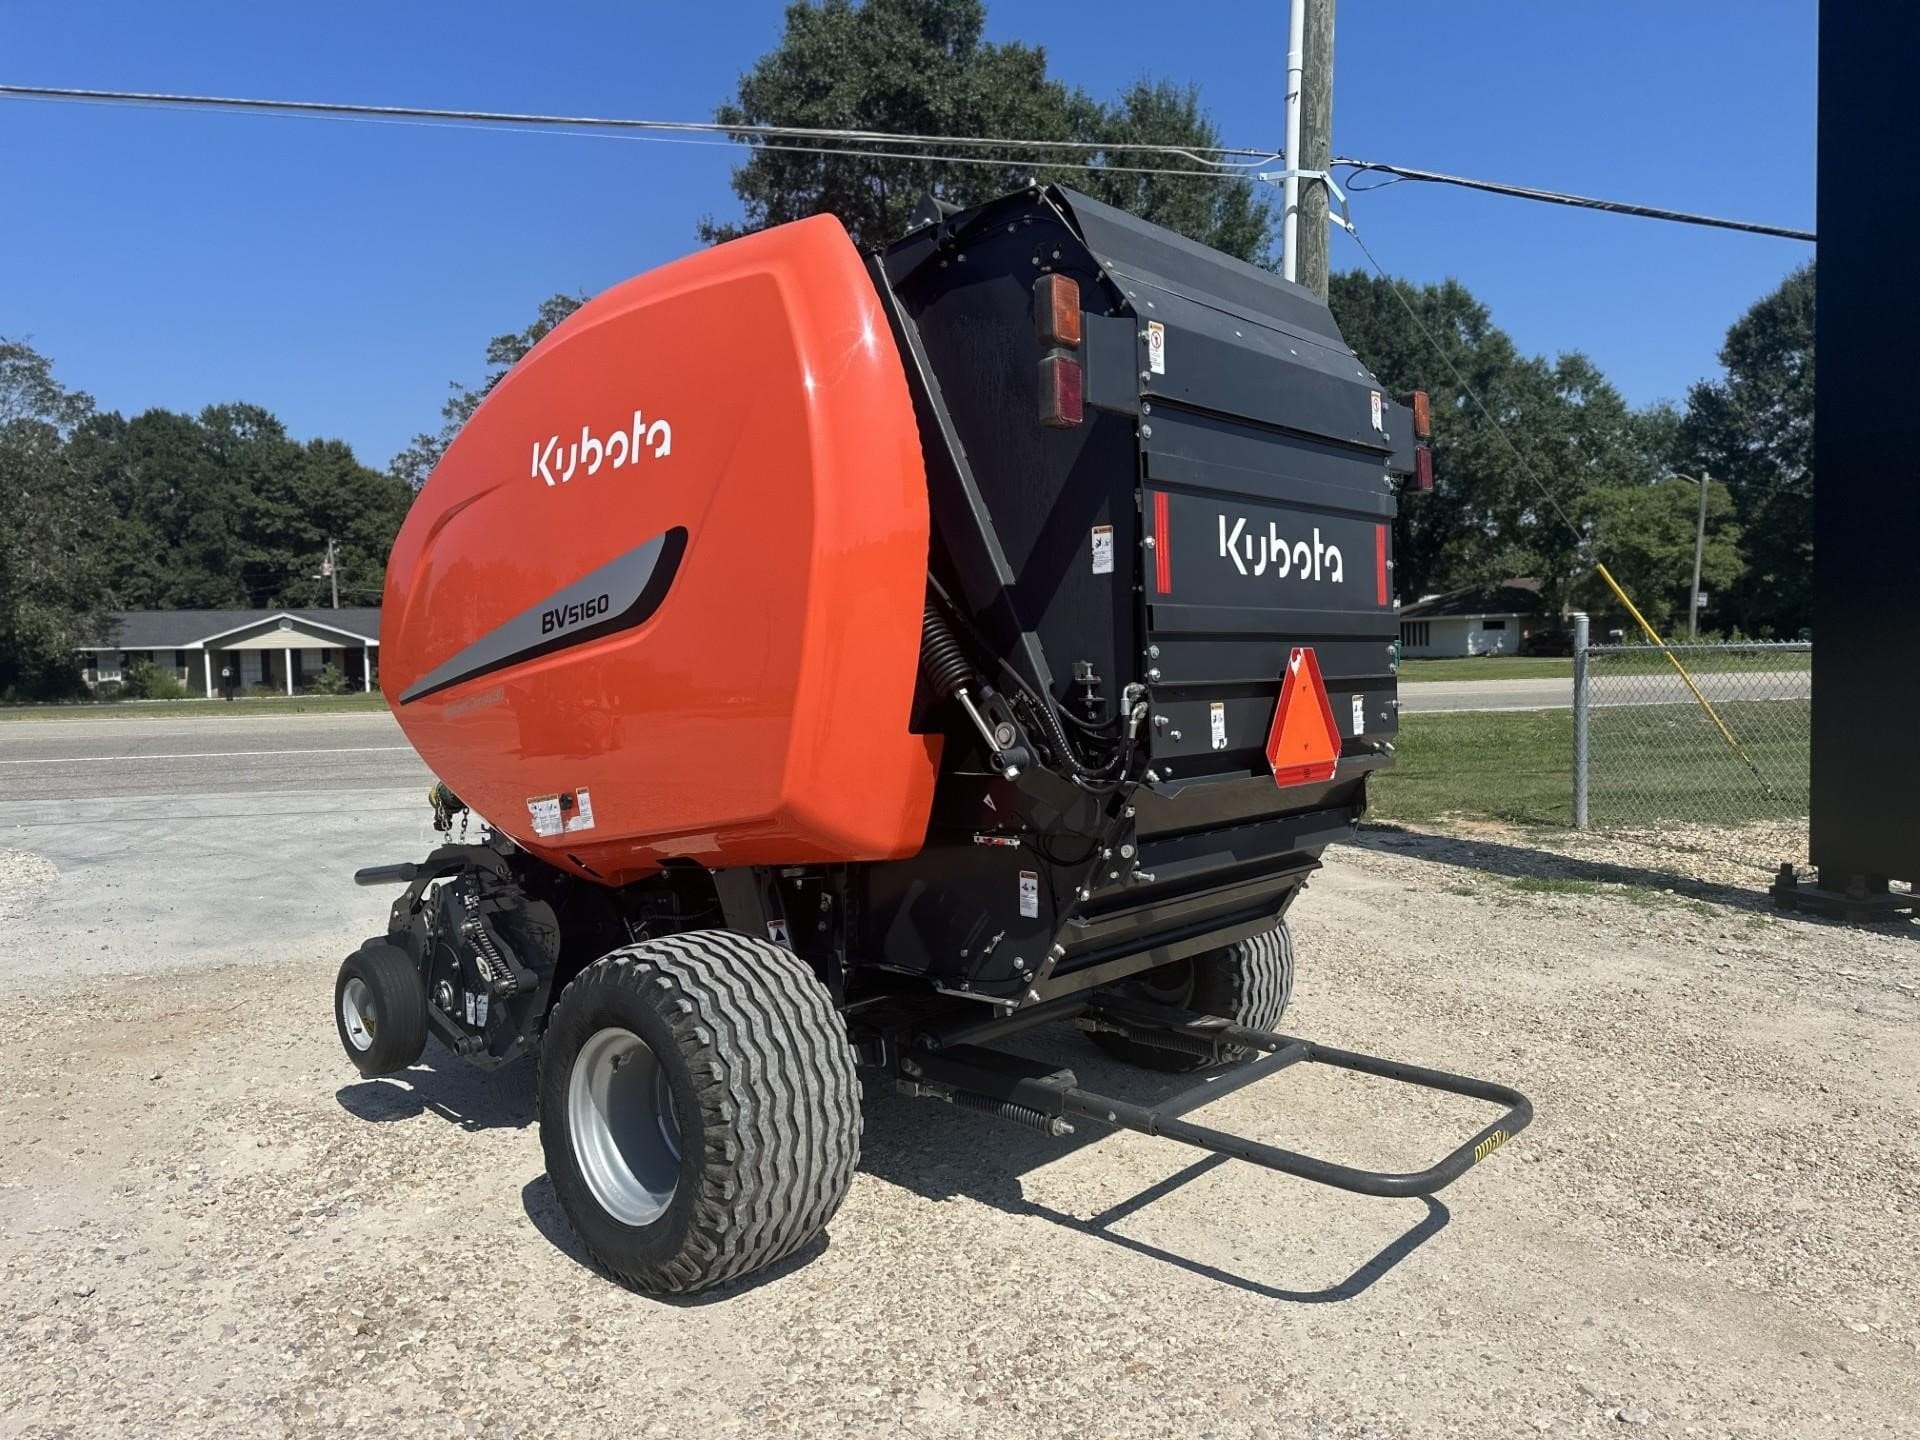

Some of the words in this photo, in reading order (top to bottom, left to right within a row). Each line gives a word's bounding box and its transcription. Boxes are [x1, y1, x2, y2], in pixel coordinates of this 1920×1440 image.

[531, 410, 672, 486] Kubota
[1218, 514, 1344, 583] Kubota
[541, 594, 609, 635] BV5160
